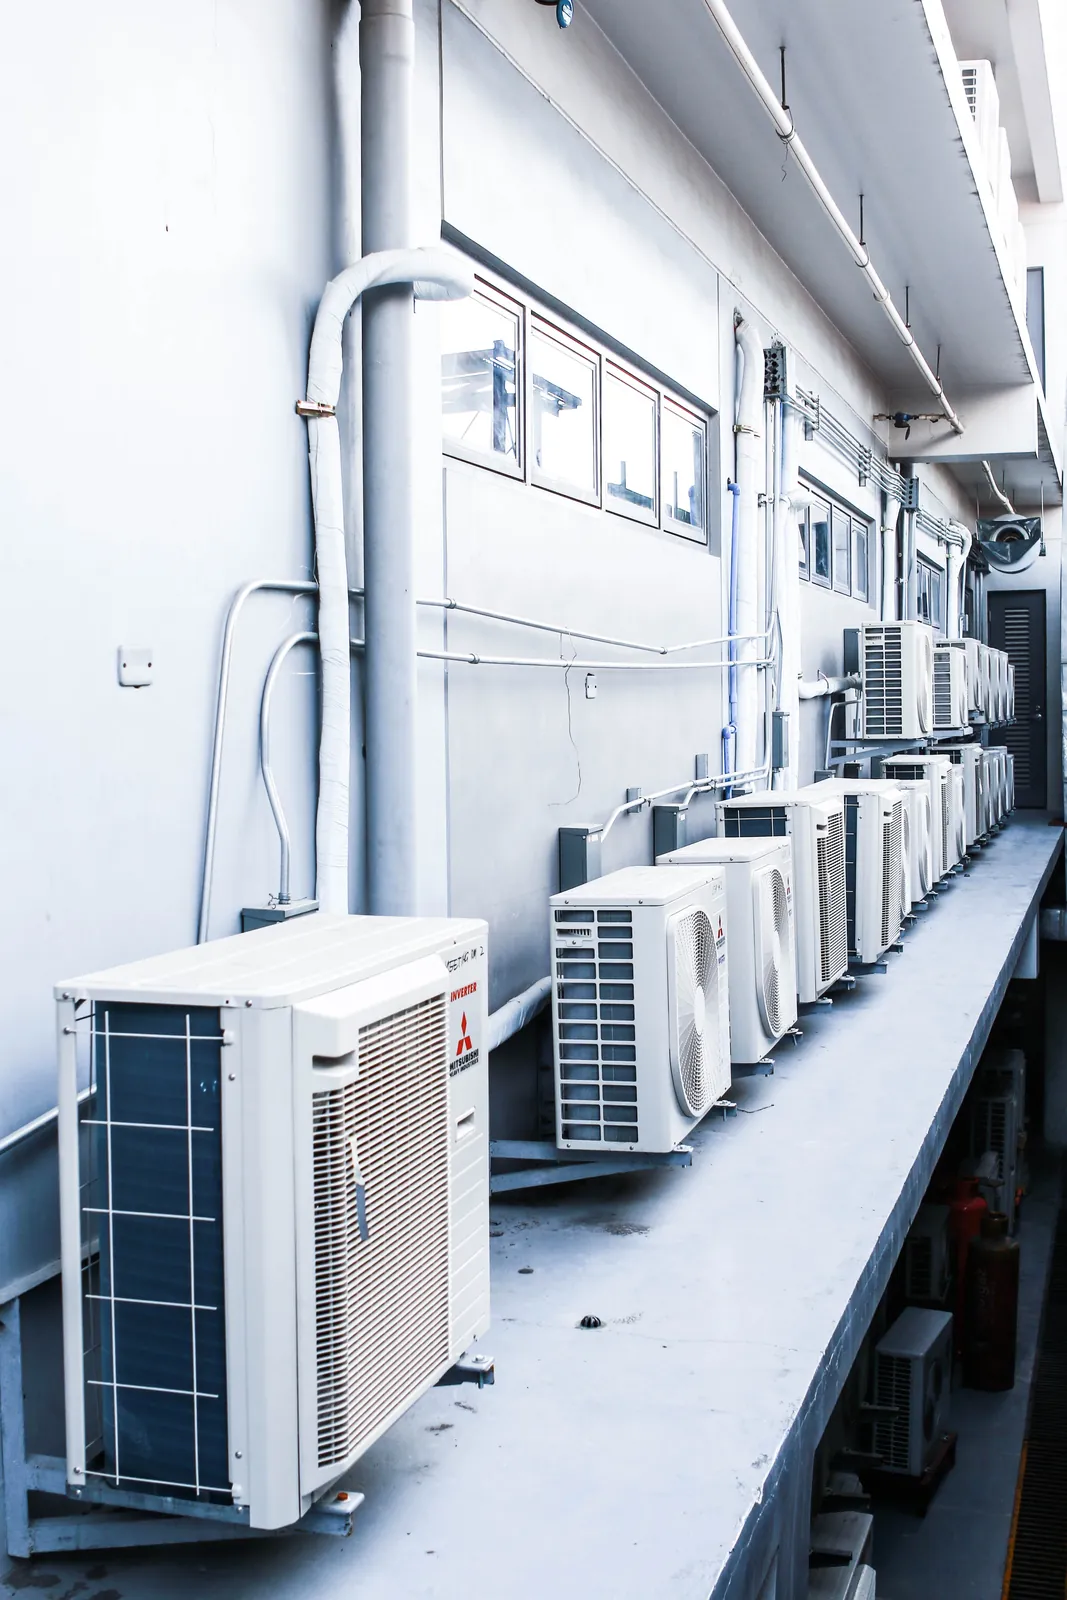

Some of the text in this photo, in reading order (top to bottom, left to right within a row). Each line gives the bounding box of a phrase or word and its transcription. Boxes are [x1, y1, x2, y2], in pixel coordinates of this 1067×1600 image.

[480, 945, 485, 956] 2
[450, 982, 476, 1002] INVERTER
[449, 1048, 479, 1071] MITSUBISHI
